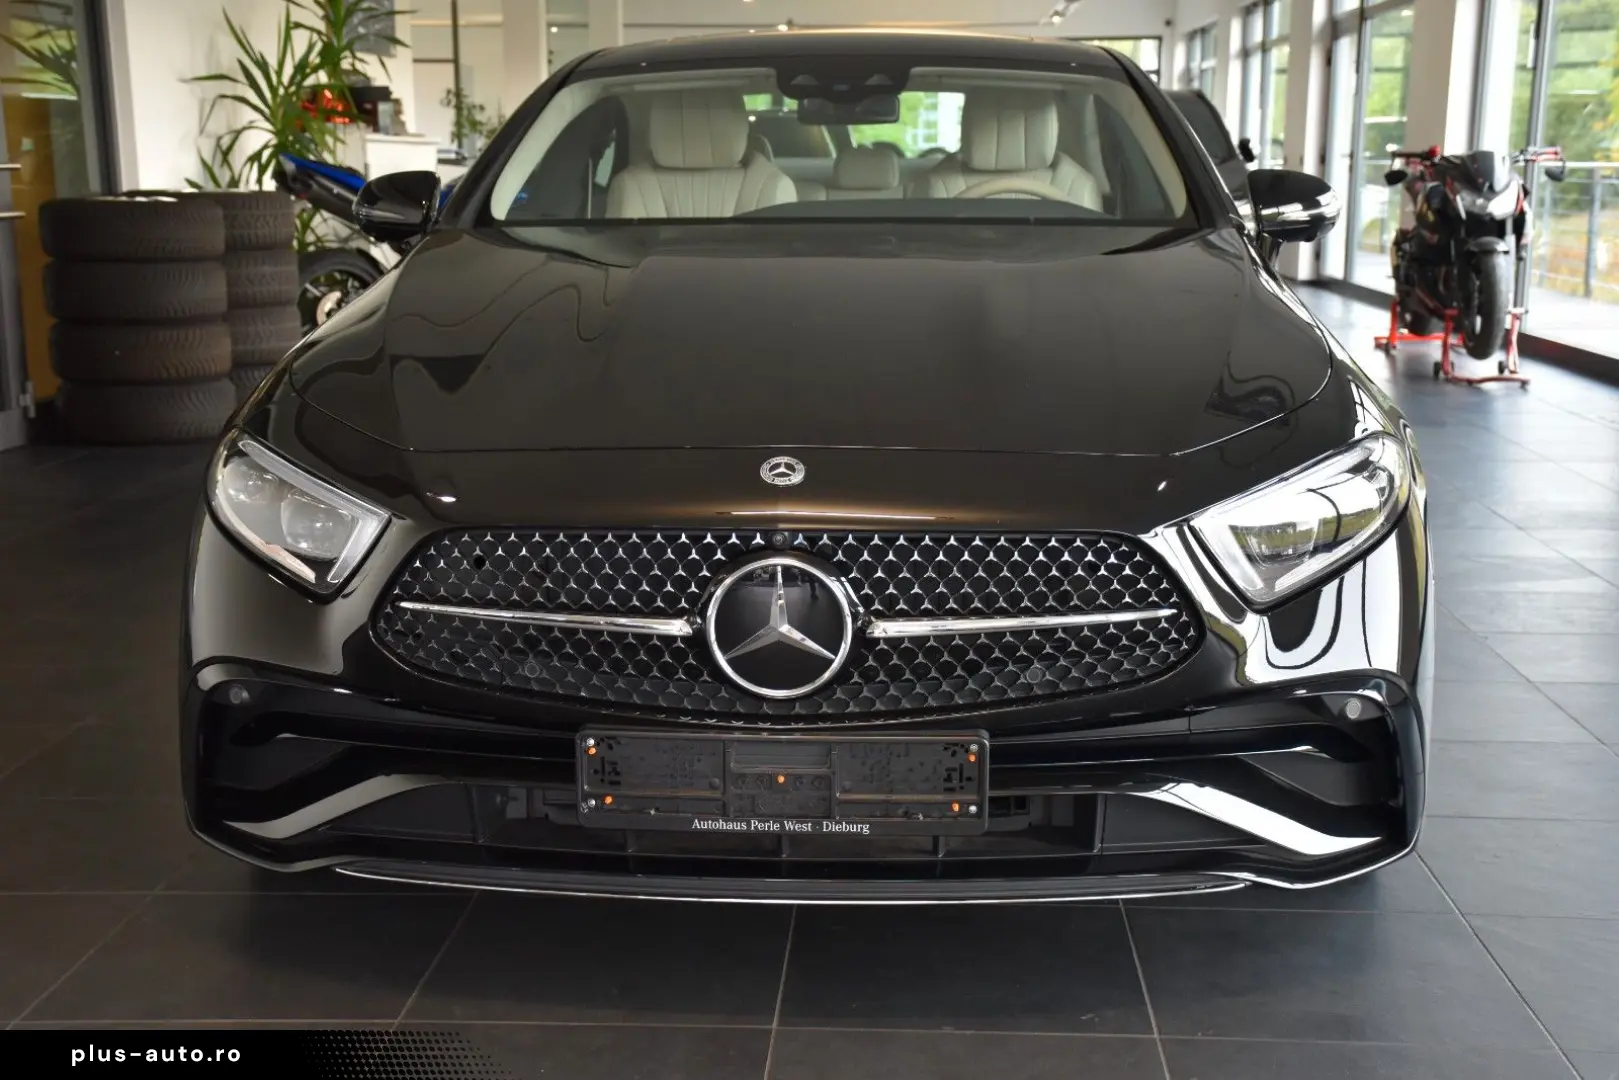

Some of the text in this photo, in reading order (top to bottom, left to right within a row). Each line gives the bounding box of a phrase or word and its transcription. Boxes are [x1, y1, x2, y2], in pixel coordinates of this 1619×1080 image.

[692, 818, 747, 831] Autohaus
[750, 819, 780, 831] Perle
[784, 820, 812, 832] West
[822, 820, 870, 835] Dieburg
